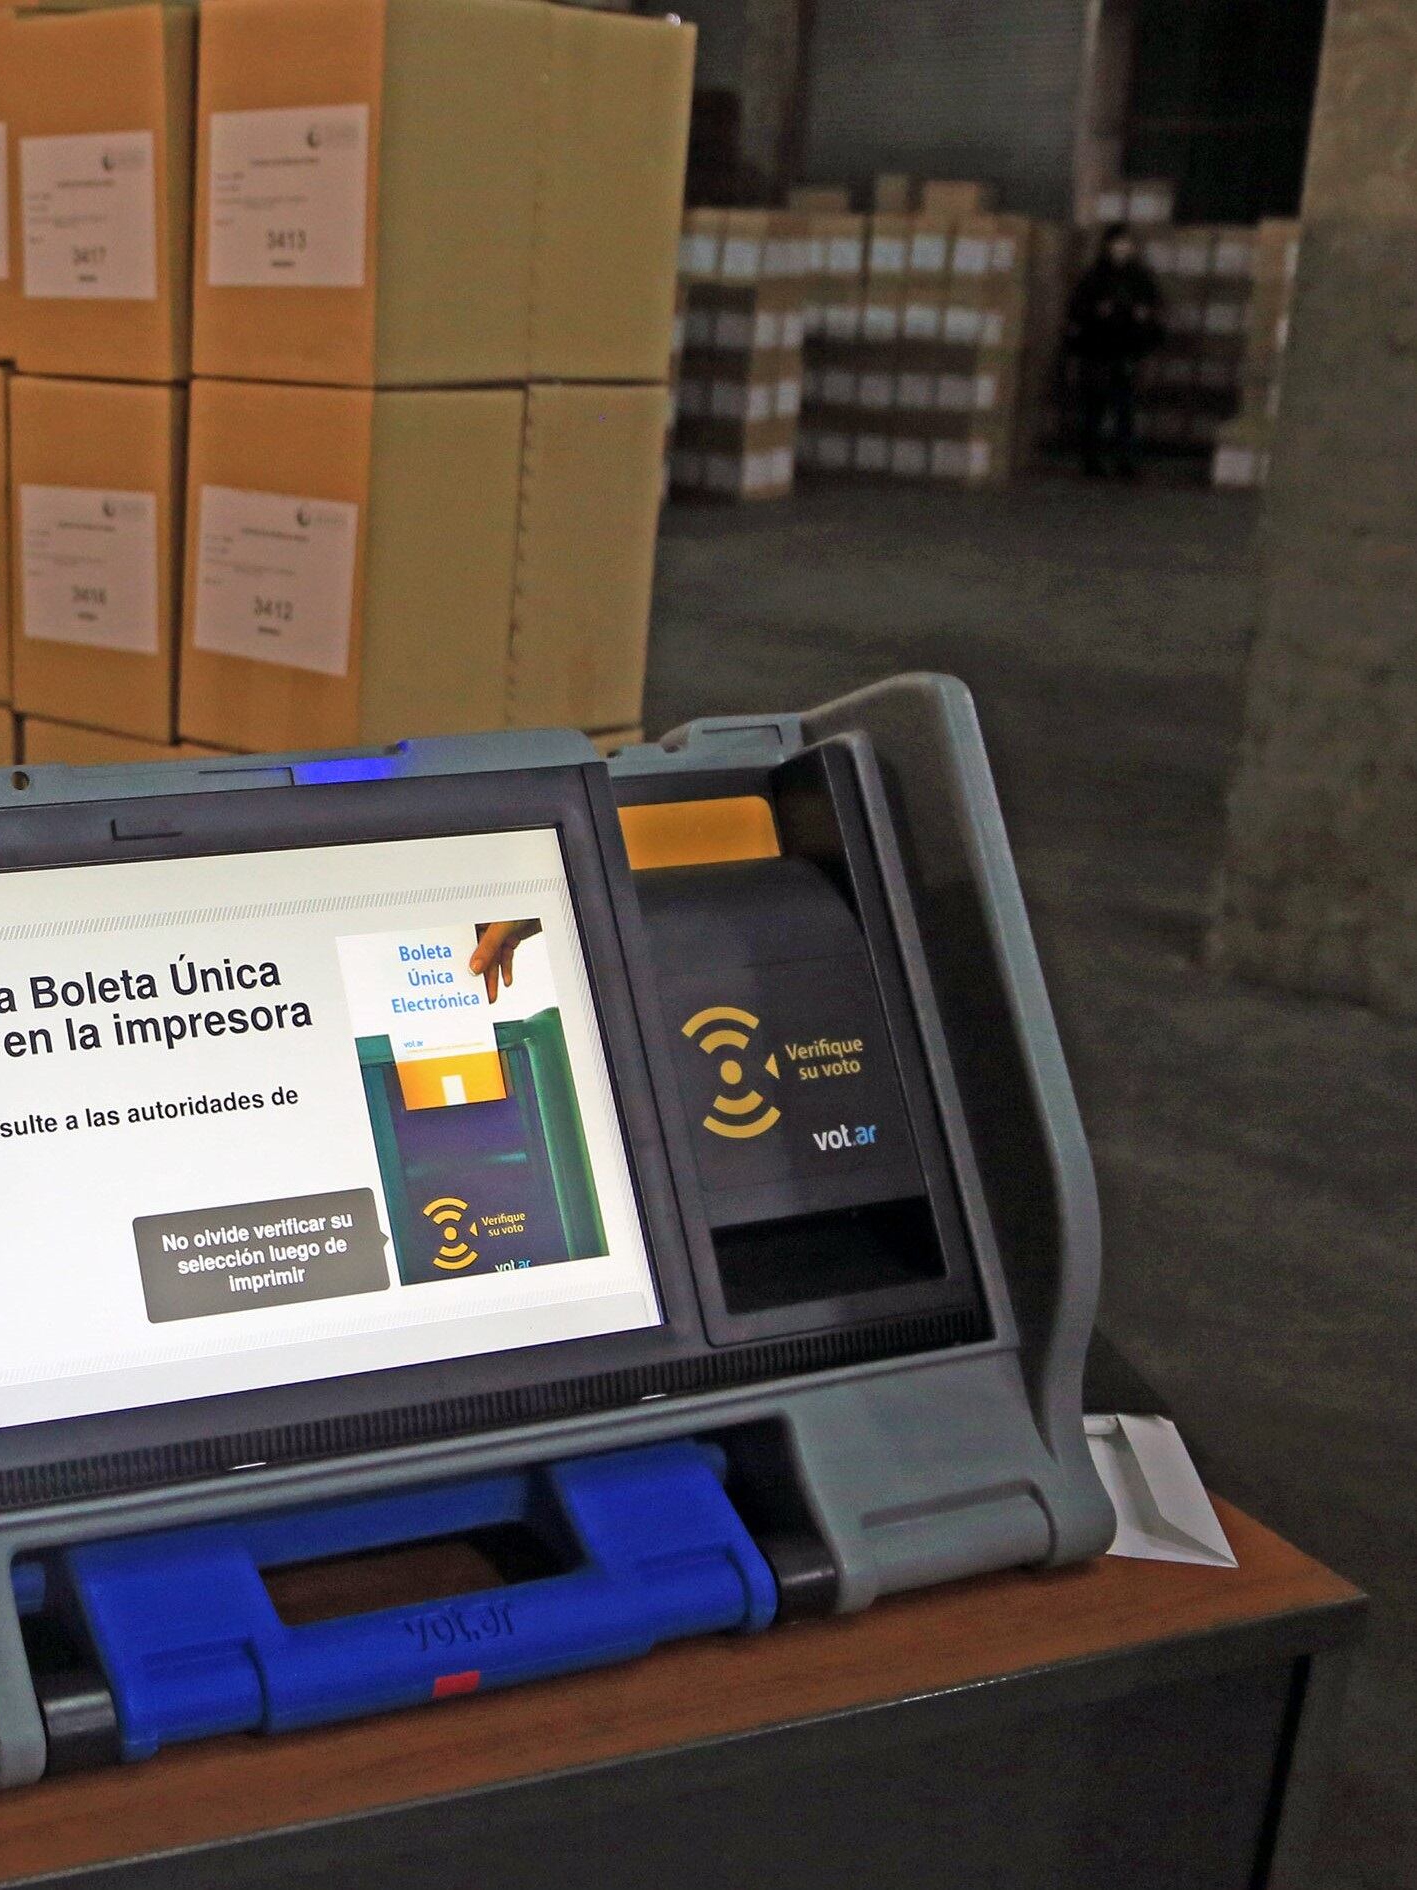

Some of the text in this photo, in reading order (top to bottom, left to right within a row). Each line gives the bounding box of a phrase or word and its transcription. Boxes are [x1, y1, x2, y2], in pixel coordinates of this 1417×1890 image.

[266, 229, 308, 253] 3413
[71, 246, 107, 266] 3417
[253, 596, 295, 622] 3412
[398, 944, 453, 962] Boleta
[29, 969, 159, 1010] Boleta
[169, 953, 282, 996] Única
[407, 967, 455, 987] Única
[391, 992, 481, 1014] Electrónica
[3, 1026, 54, 1058] en
[65, 1017, 103, 1052] la
[112, 999, 314, 1050] impresora
[785, 1038, 864, 1061] Verifique
[799, 1059, 862, 1080] su voto
[66, 1114, 80, 1131] a
[86, 1108, 122, 1128] las
[127, 1092, 265, 1124] autoridades
[271, 1086, 300, 1106] de
[812, 1123, 878, 1151] vot.ar
[481, 1212, 527, 1226] Verifique
[488, 1223, 525, 1237] su voto
[162, 1212, 353, 1252] No olvide verificar su
[178, 1237, 349, 1275] selección luego de
[229, 1267, 306, 1293] imprimir
